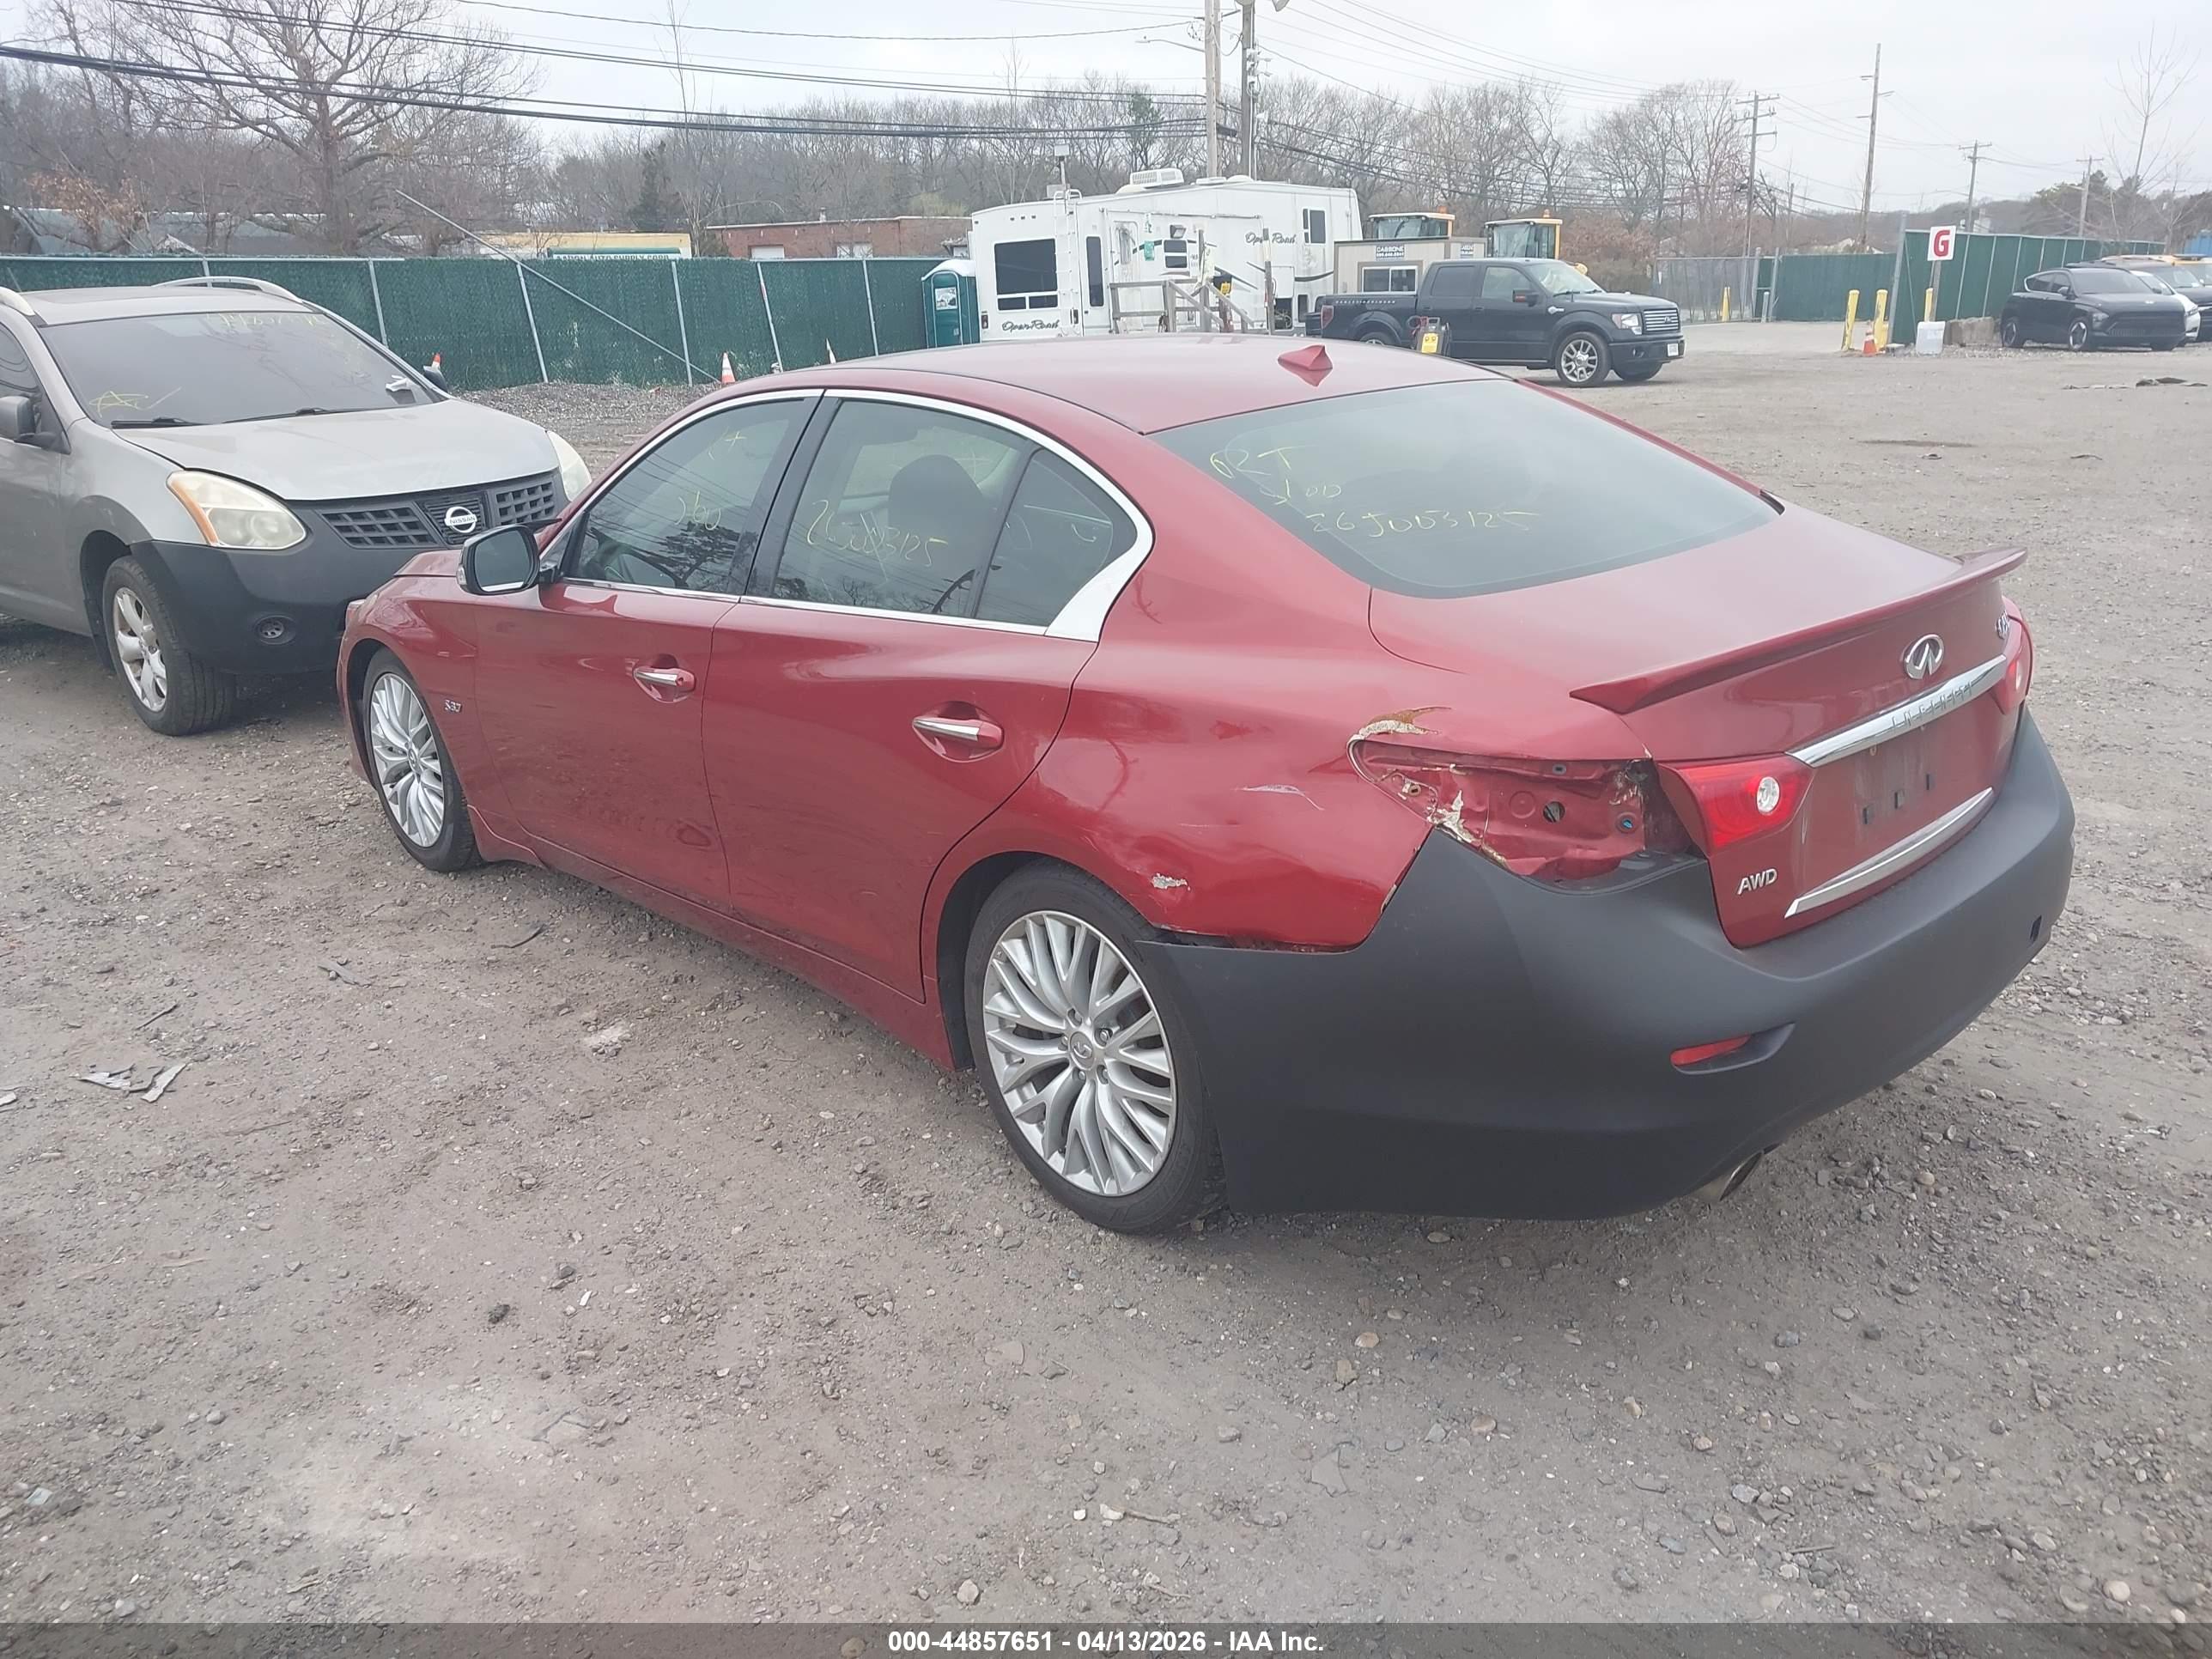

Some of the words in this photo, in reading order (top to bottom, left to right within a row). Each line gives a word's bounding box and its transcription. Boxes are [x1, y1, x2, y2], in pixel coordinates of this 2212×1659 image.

[1934, 230, 1950, 257] G
[449, 515, 476, 525] NISSAN
[1737, 868, 1778, 895] AWD
